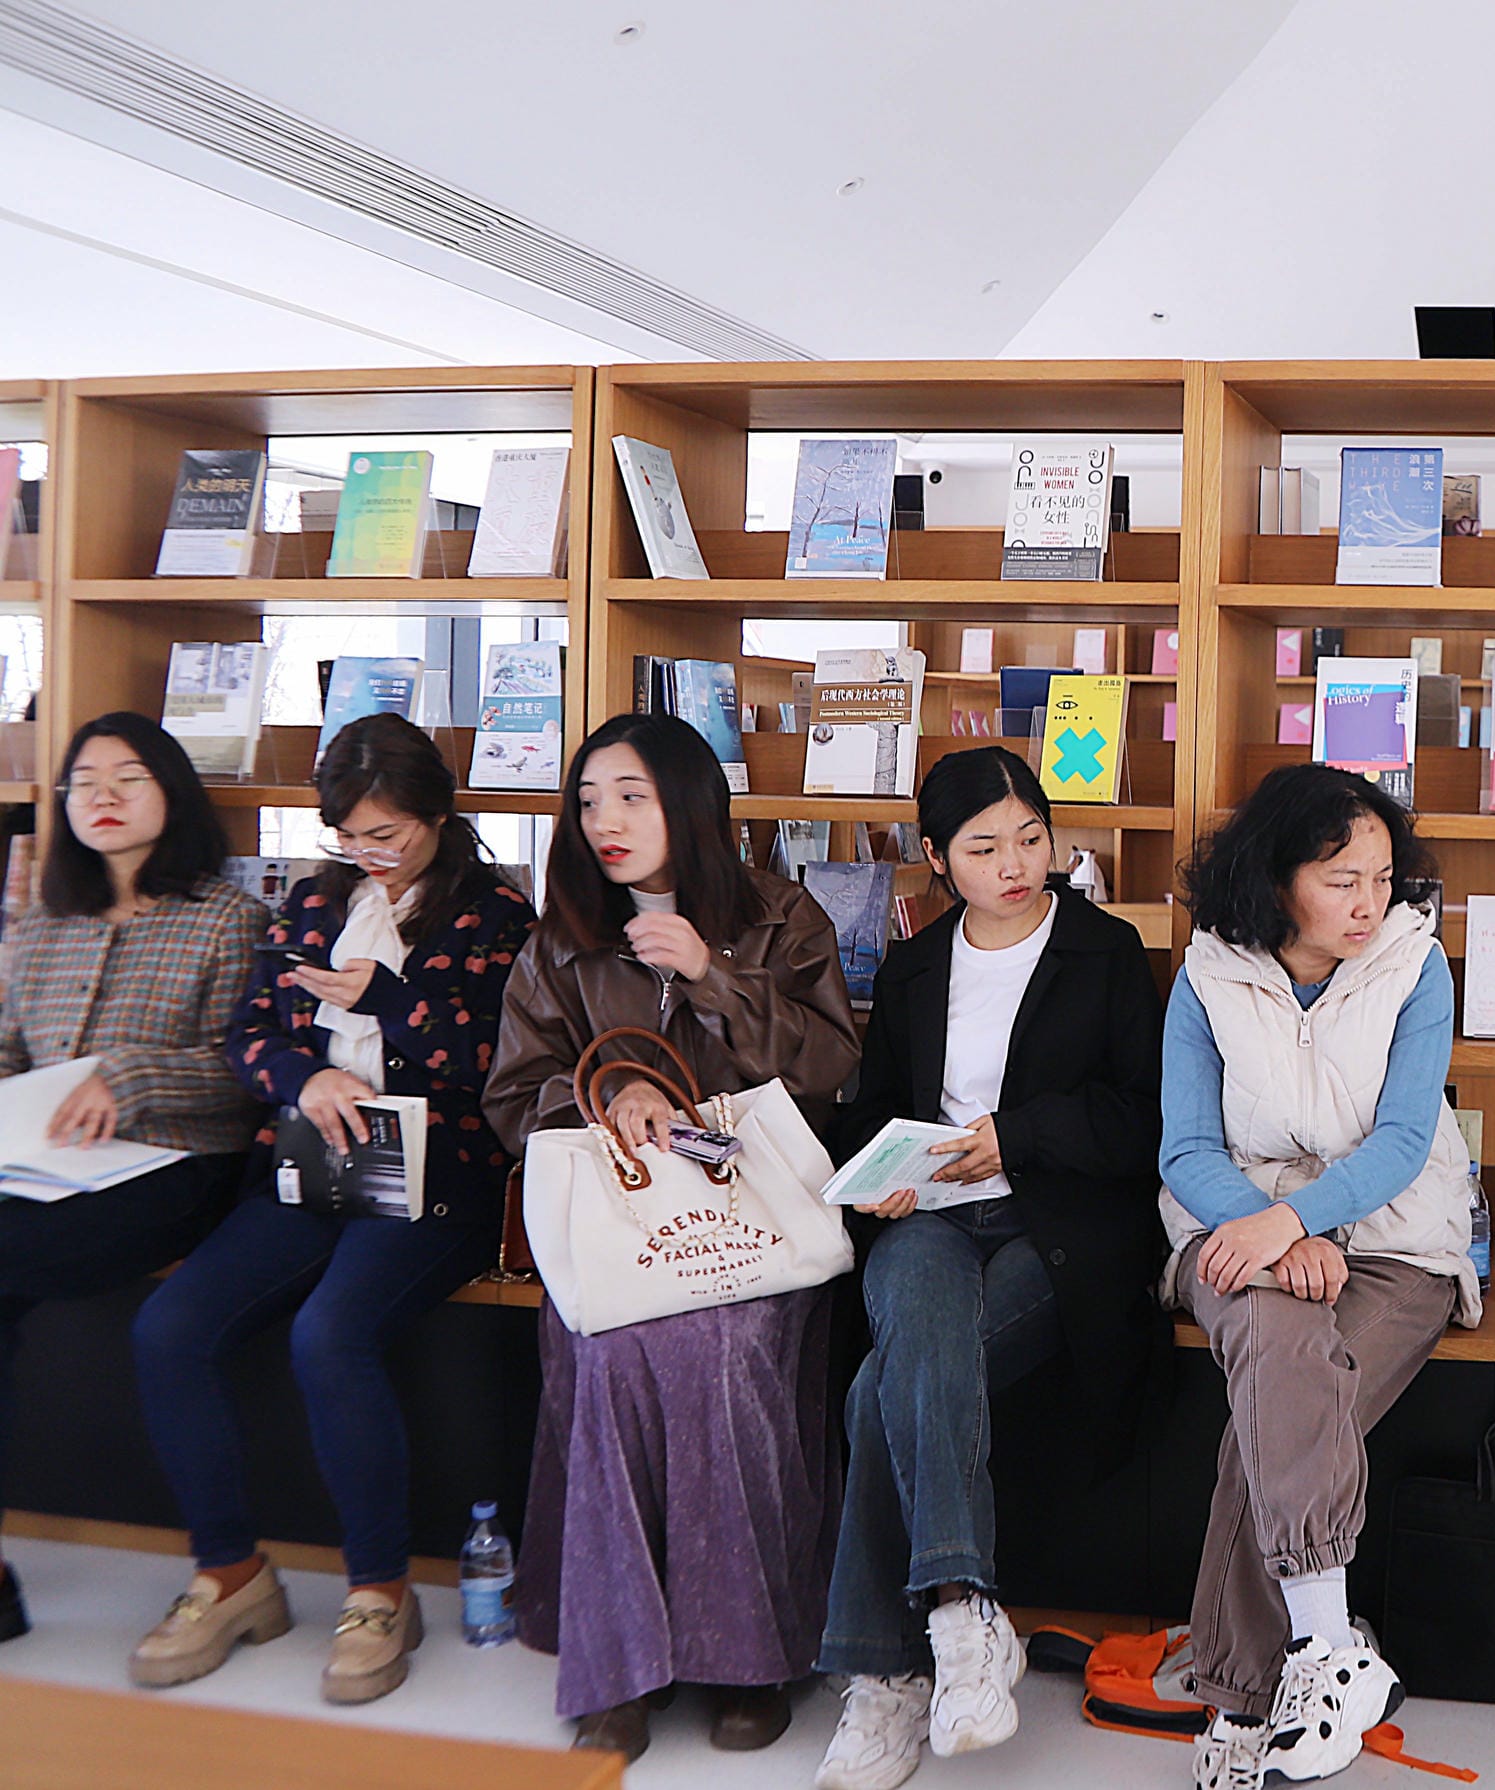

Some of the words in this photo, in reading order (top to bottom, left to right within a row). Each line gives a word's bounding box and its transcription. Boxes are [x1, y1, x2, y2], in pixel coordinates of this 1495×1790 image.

[1349, 453, 1400, 464] THE
[1040, 467, 1080, 477] INVISIBLE
[1350, 467, 1400, 478] THIRD
[1423, 454, 1434, 491] 第三次
[1044, 480, 1075, 490] WOMEN
[177, 498, 245, 513] DEMAIN
[1031, 495, 1085, 509] 看不见的
[1044, 511, 1070, 524] 女性
[846, 534, 871, 545] Peace
[821, 687, 905, 702] 后现代西方社会学理论
[1327, 693, 1371, 707] History
[503, 702, 543, 714] 自然笔记
[664, 1241, 721, 1264] FACIAL
[724, 1240, 763, 1251] MASK
[677, 1254, 763, 1278] SUPERMARKET
